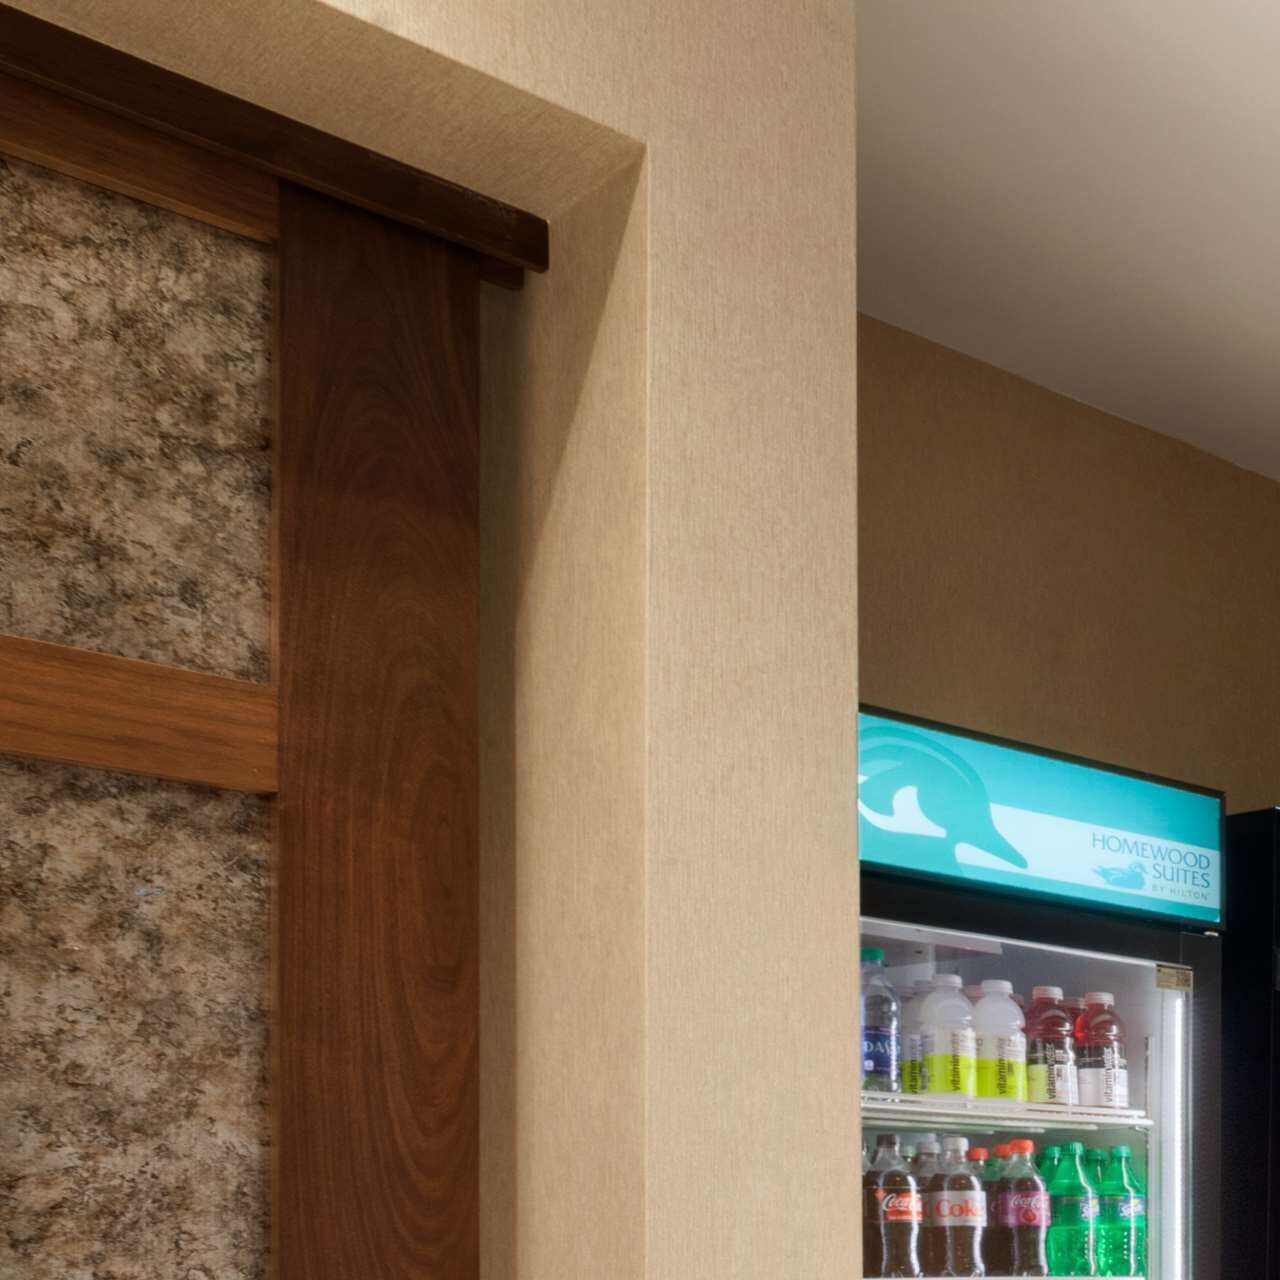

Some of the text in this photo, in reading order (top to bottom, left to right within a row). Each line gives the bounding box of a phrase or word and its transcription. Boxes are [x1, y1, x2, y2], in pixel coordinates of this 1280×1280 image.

[1091, 831, 1211, 870] HOMEWOOD
[1151, 863, 1211, 889] SUITES
[1169, 887, 1209, 901] HILTON
